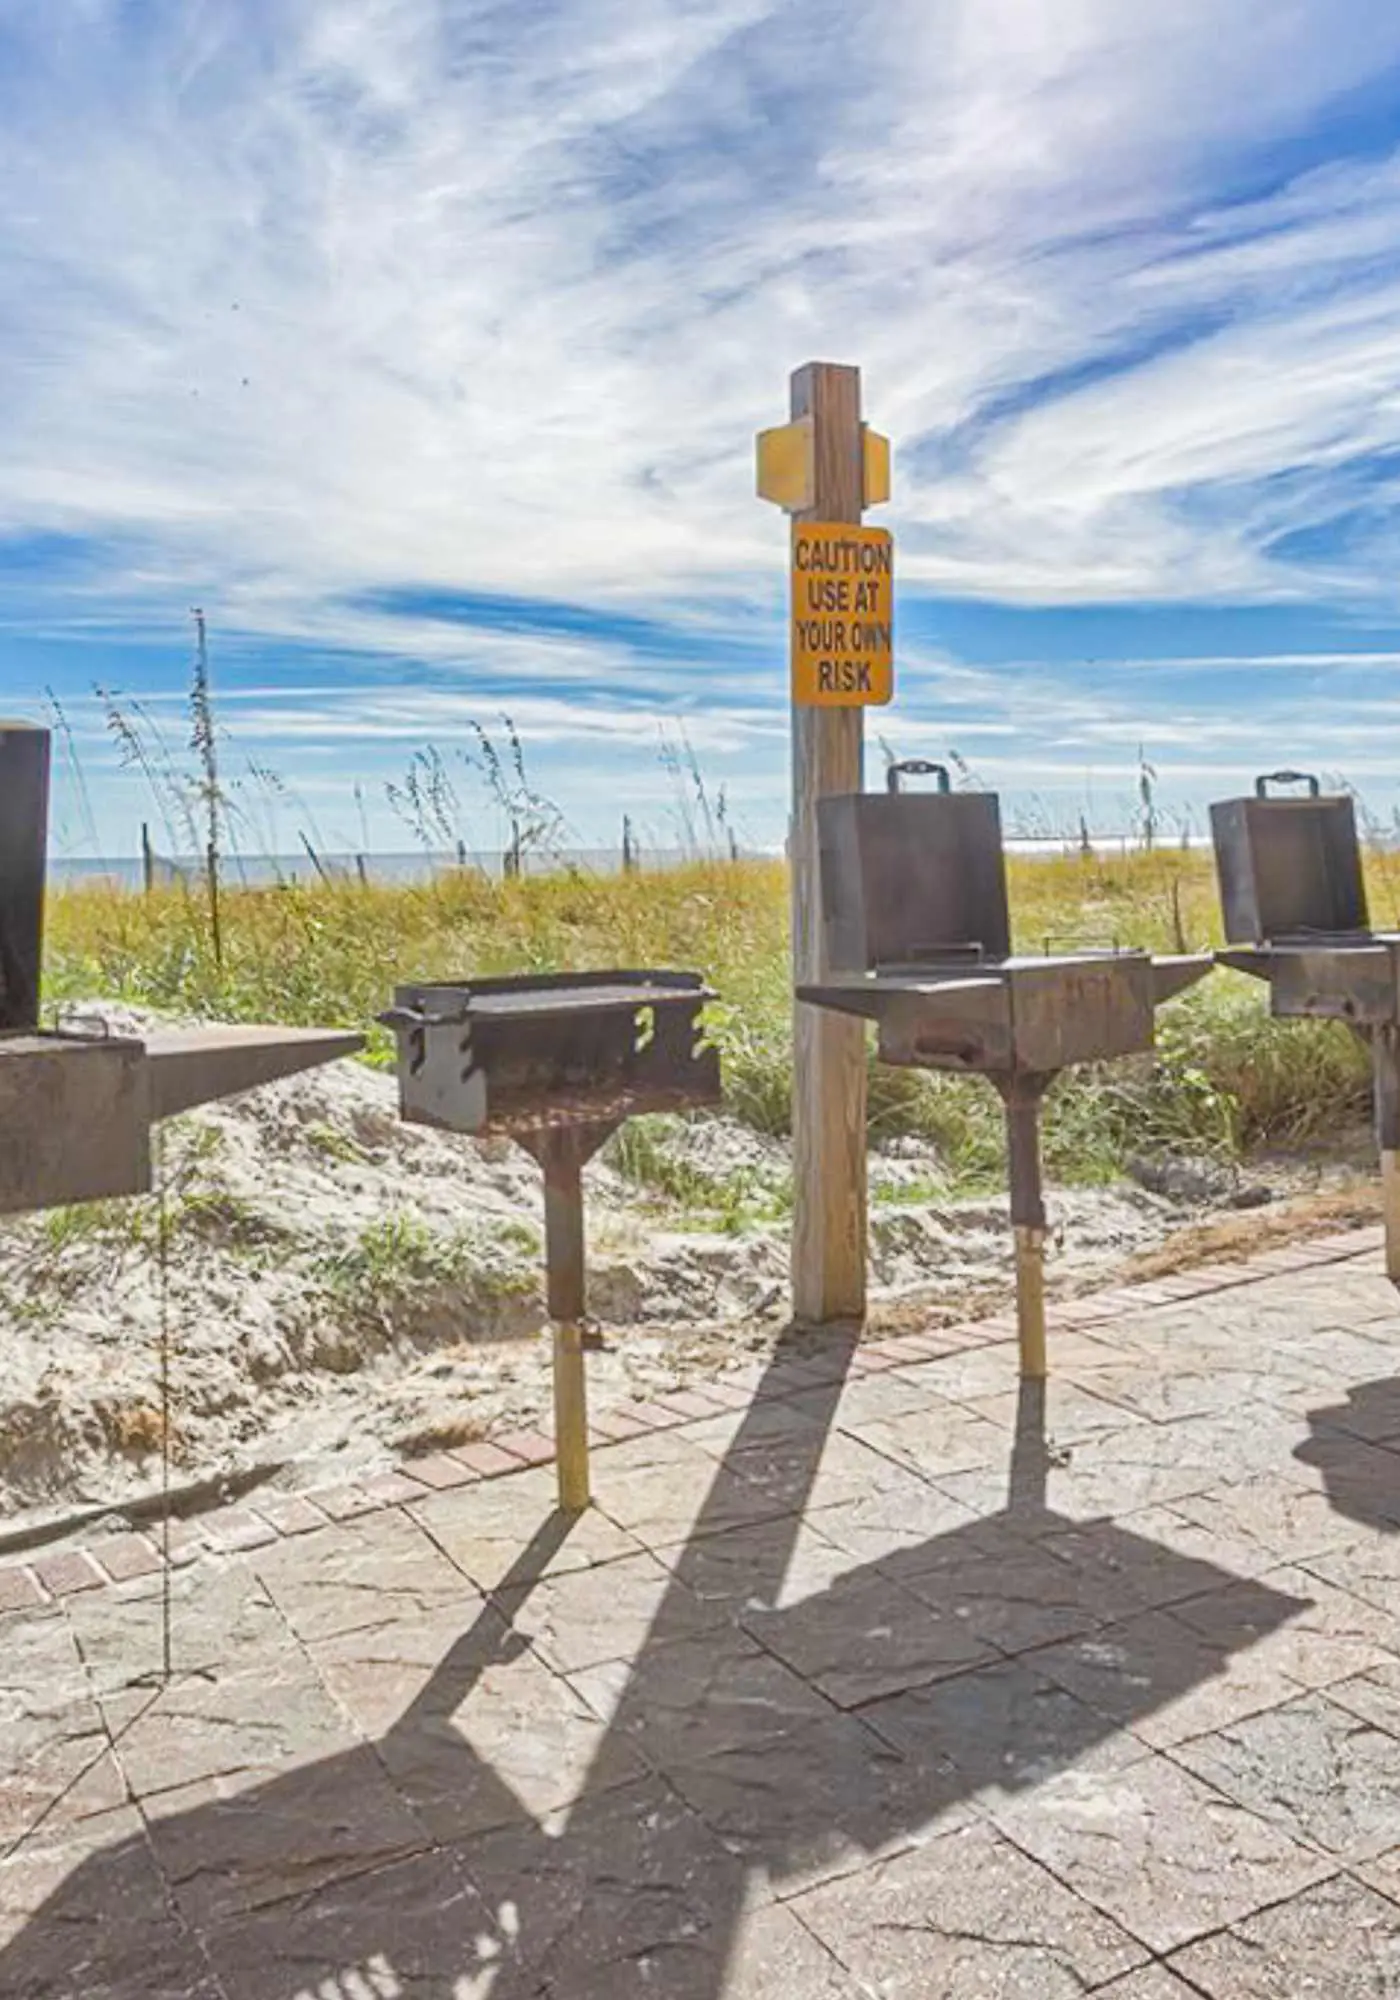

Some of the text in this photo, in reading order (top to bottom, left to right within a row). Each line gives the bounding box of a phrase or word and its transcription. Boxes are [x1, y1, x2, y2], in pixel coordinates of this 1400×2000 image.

[795, 539, 891, 574] CAUTION
[807, 577, 879, 612] USE AT
[795, 620, 891, 653] YOUR OWN
[818, 660, 871, 692] RISK
